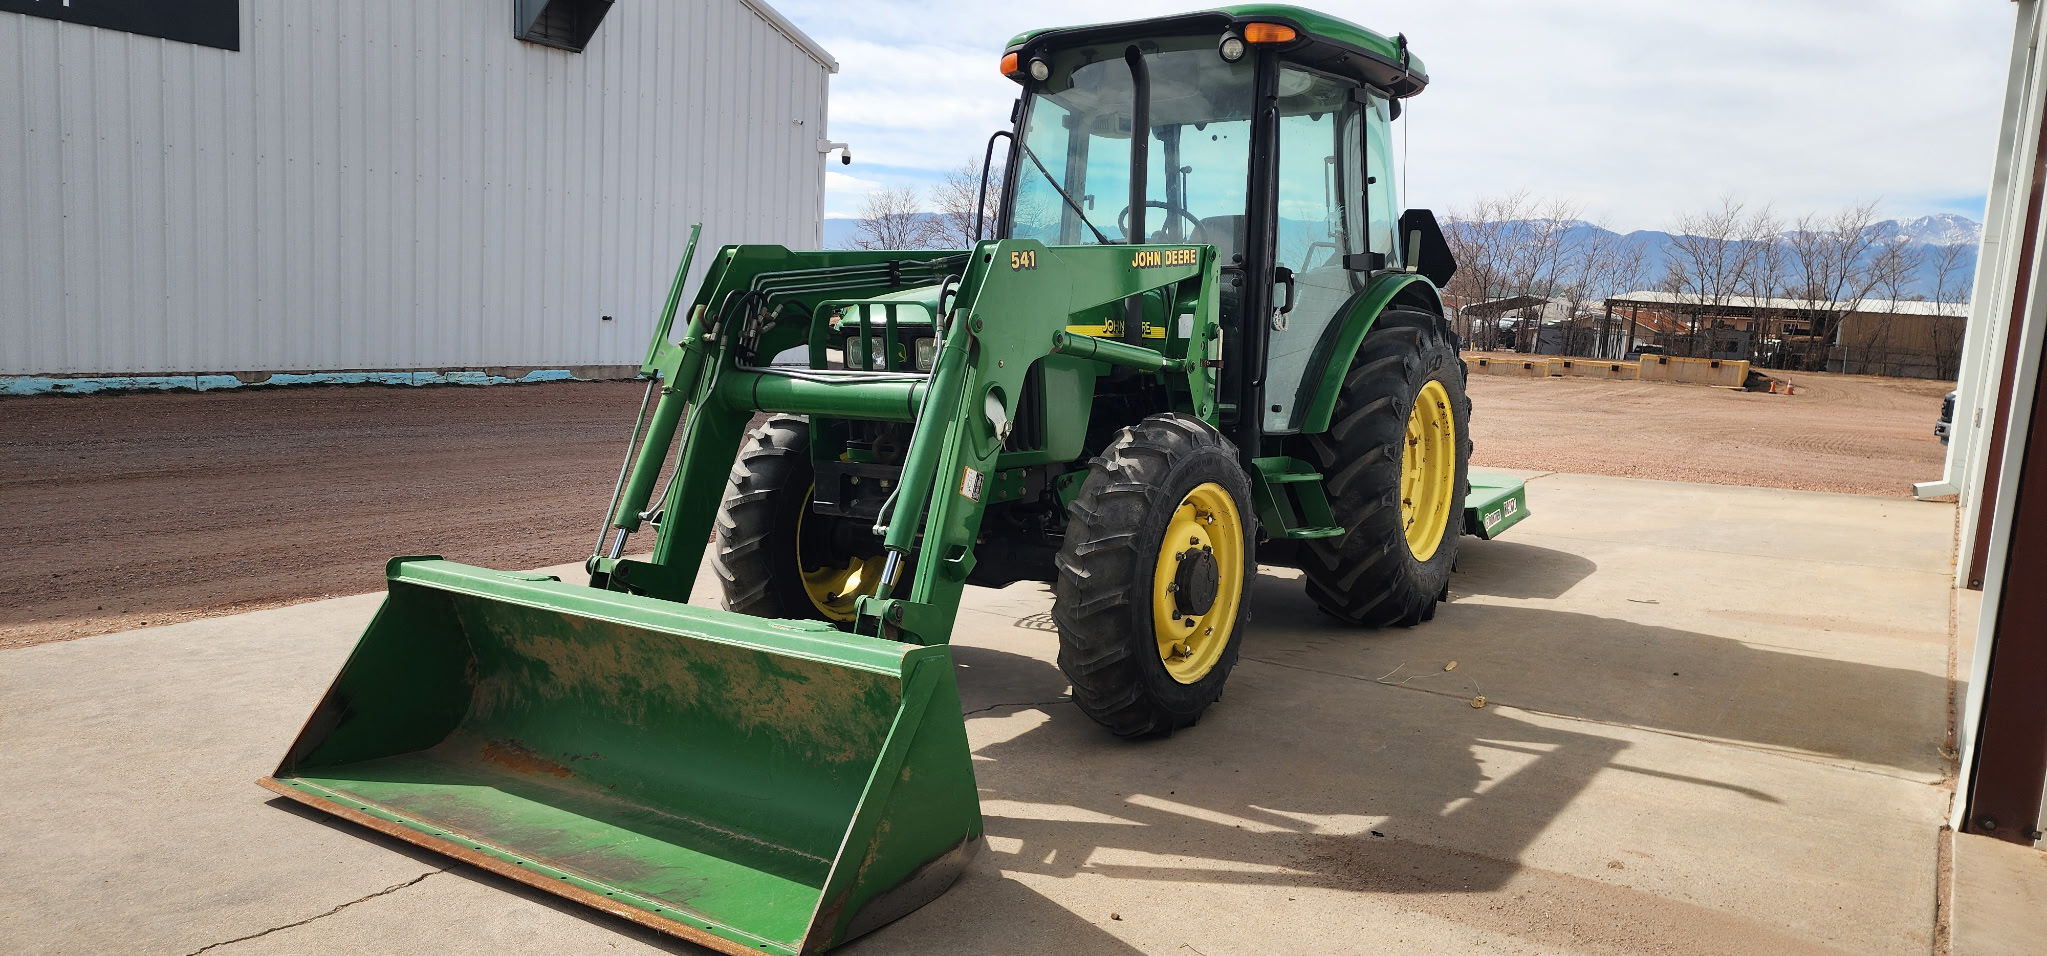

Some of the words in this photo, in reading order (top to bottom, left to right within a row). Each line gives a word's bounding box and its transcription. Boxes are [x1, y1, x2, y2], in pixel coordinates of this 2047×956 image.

[1011, 250, 1037, 271] 541
[1132, 250, 1162, 268] JOHN
[1165, 249, 1196, 266] DEERE
[1103, 317, 1125, 333] JOHN
